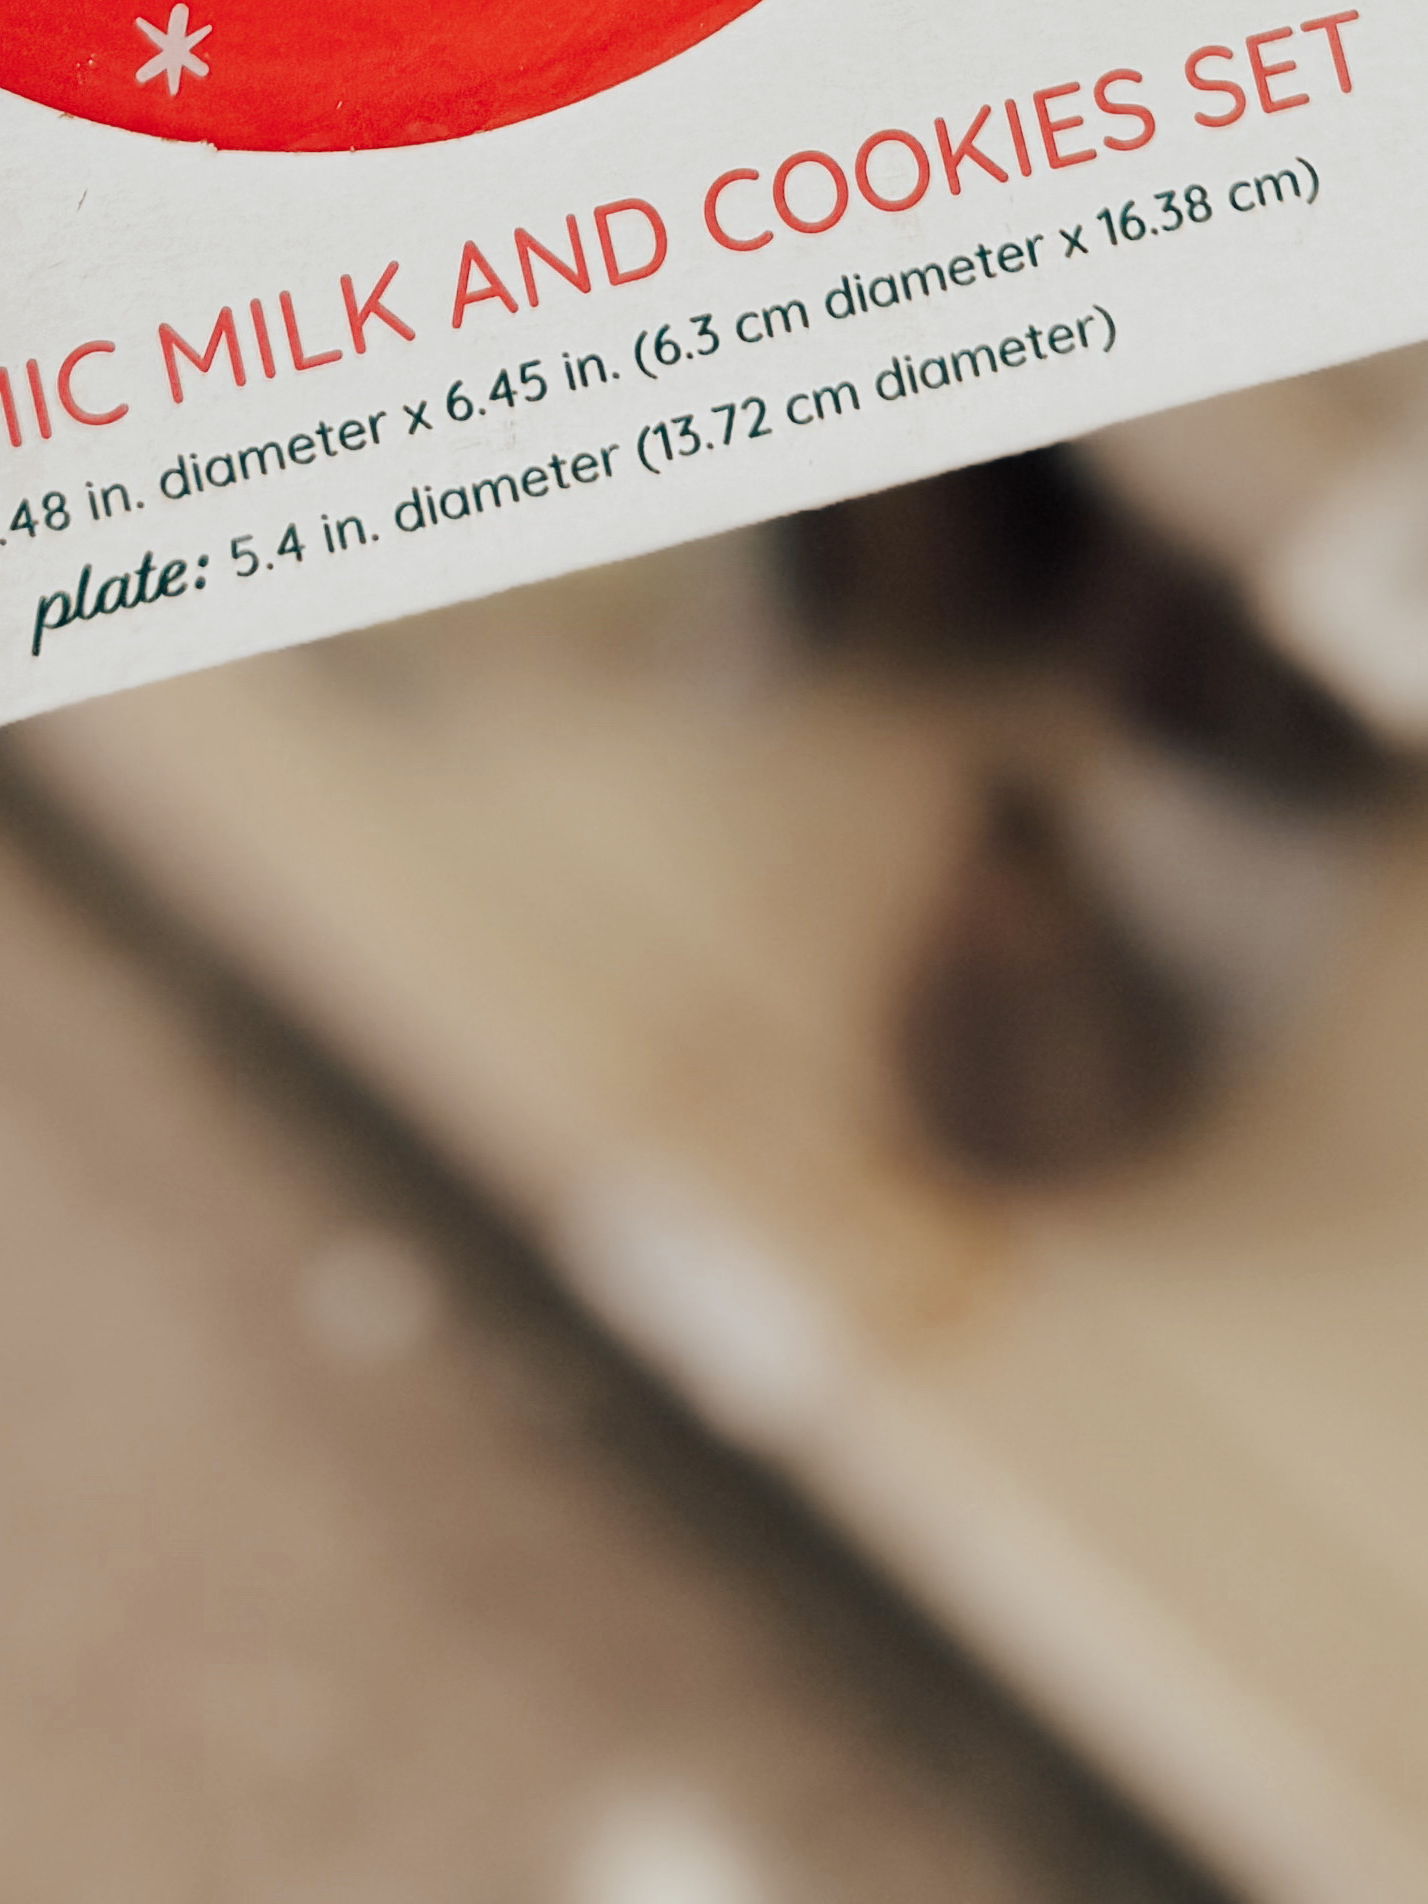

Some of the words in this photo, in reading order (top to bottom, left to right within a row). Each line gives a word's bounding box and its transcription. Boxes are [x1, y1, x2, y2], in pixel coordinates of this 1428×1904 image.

[86, 480, 144, 522] in.
[159, 408, 386, 501] diameter
[407, 404, 433, 435] x
[446, 359, 547, 423] 6.45
[563, 344, 619, 392] in.
[635, 315, 720, 379] (6.3
[735, 294, 810, 344] cm
[825, 229, 1044, 320] diameter
[1061, 226, 1088, 256] x
[1095, 194, 1212, 247] 16.38
[1229, 156, 1320, 212] cm)
[159, 261, 415, 403] MILK
[452, 197, 668, 330] AND
[704, 69, 1156, 252] COOKIES
[1184, 10, 1359, 128] SET
[31, 553, 209, 655] plate:
[230, 522, 306, 578] 5.4
[321, 510, 379, 555] in.
[393, 440, 619, 533] diameter
[636, 396, 773, 474] (13.72
[786, 379, 862, 427] cm
[875, 305, 1118, 400] diameter)
